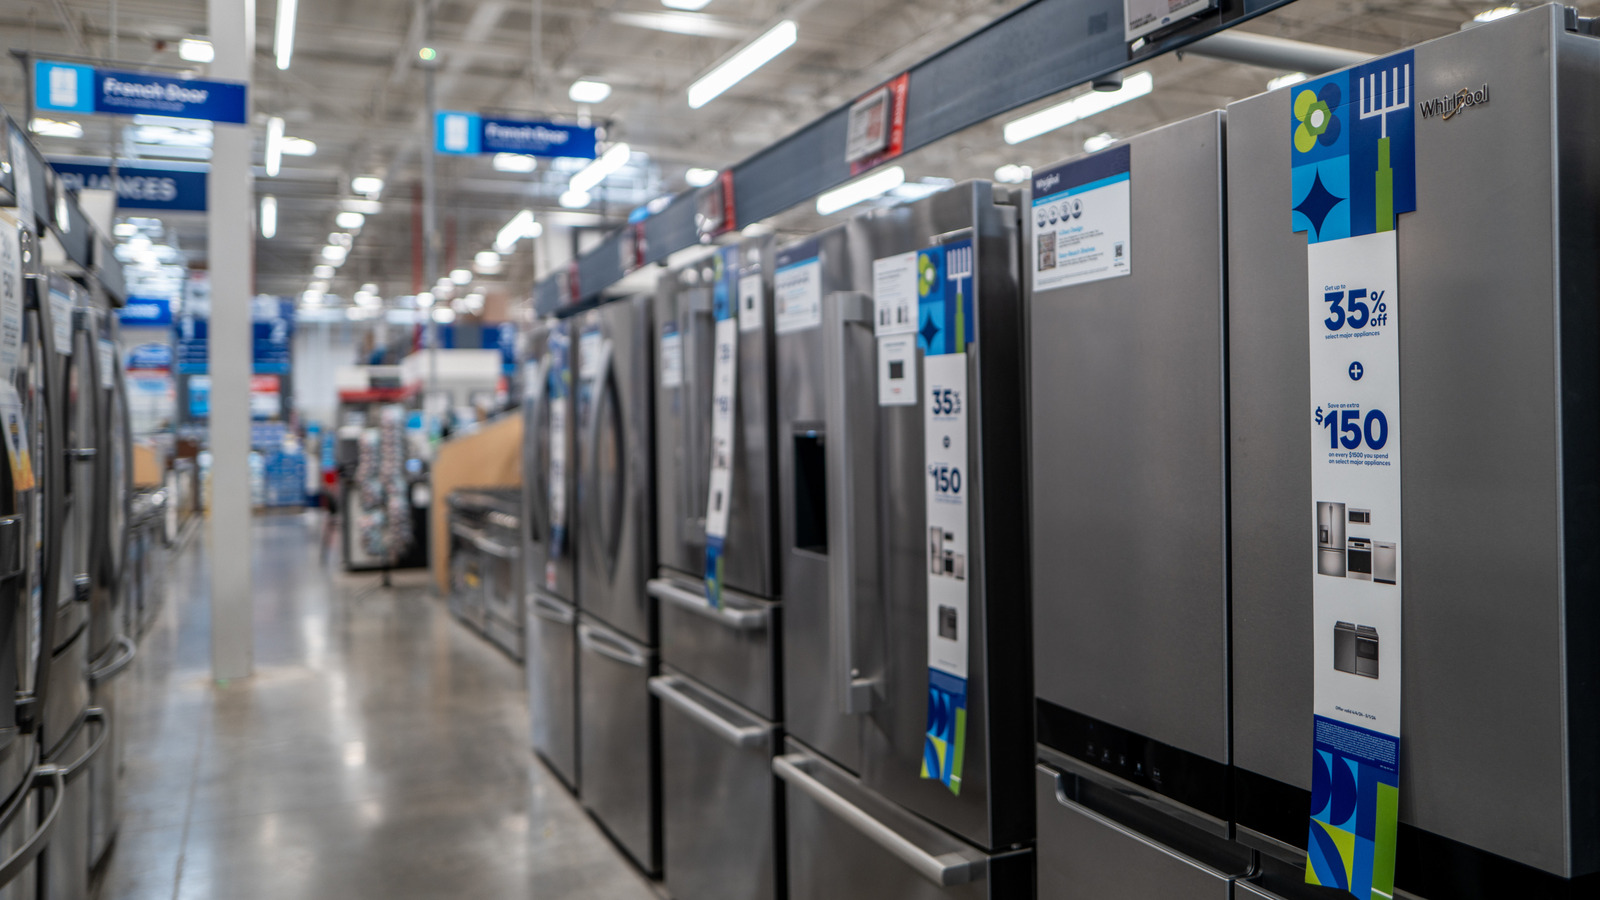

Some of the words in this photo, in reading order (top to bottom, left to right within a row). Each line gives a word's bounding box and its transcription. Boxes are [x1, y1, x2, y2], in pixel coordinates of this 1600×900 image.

[103, 77, 165, 101] French
[165, 83, 209, 104] Door
[1419, 83, 1489, 120] Whirlpool
[60, 172, 178, 202] PLIANCES
[1324, 288, 1386, 331] 35%
[1370, 313, 1387, 327] off
[1315, 406, 1388, 450] $150
